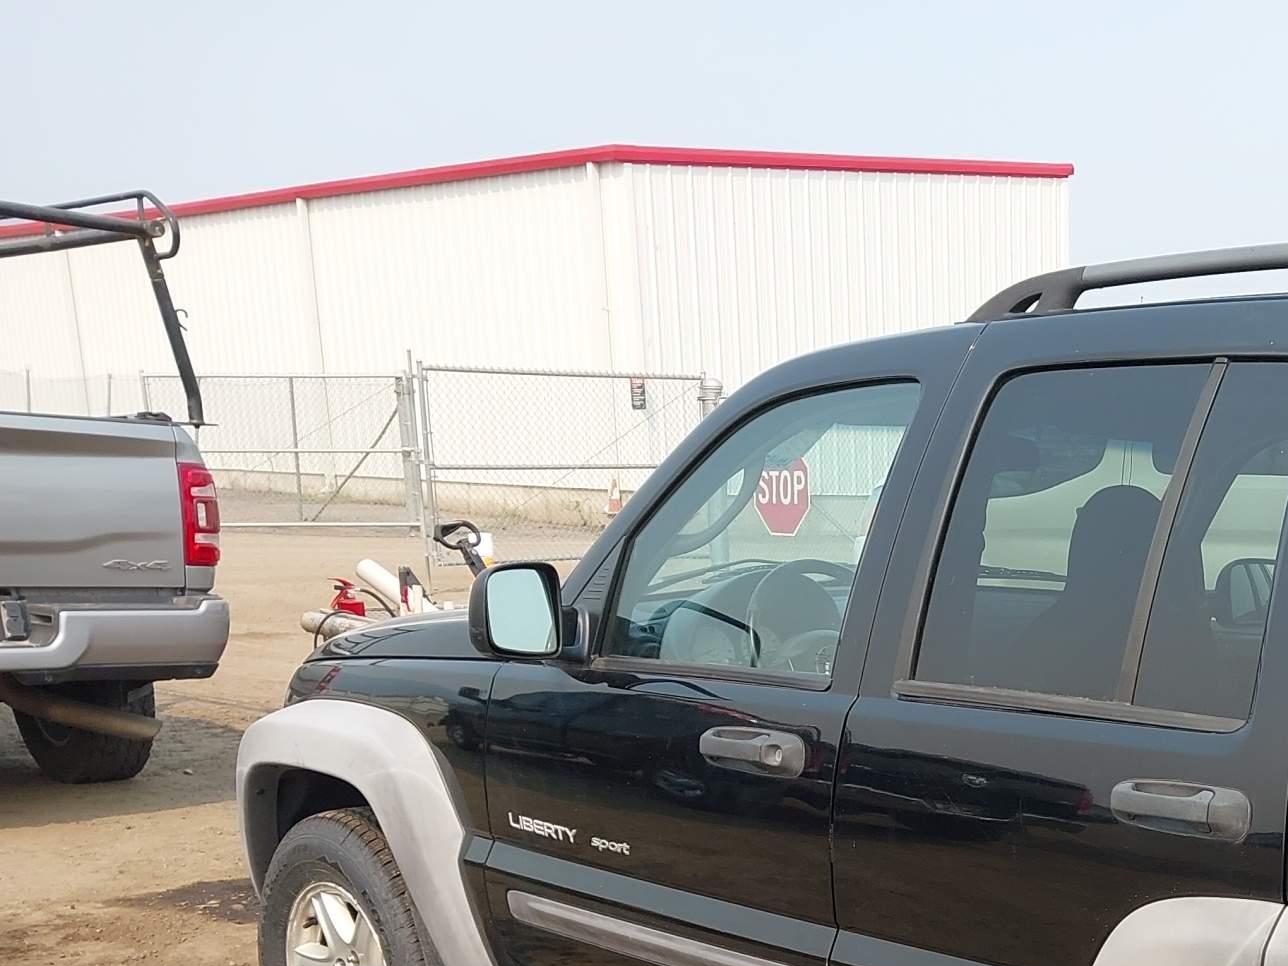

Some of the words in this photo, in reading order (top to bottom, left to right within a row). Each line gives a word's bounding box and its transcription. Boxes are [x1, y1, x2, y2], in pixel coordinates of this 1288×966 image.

[758, 469, 805, 505] STOP
[507, 812, 577, 843] LIBERTY
[590, 837, 630, 856] sport
